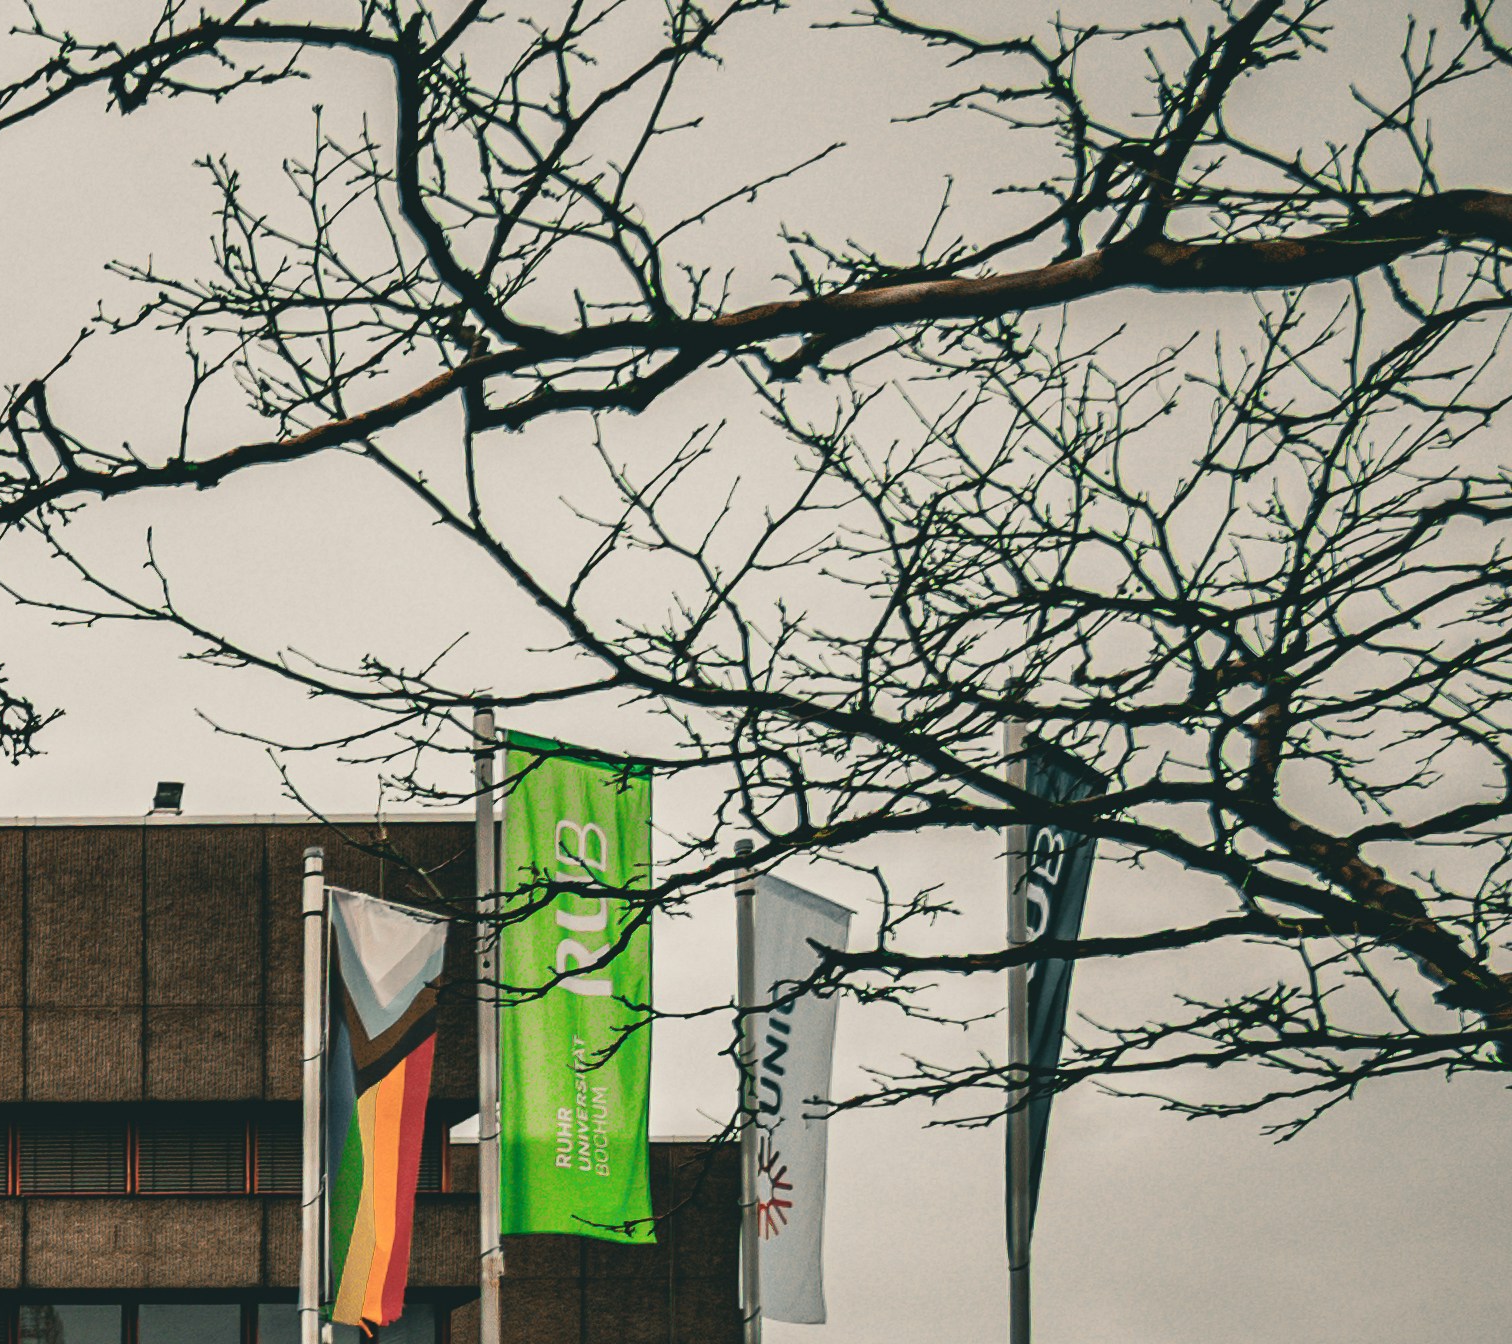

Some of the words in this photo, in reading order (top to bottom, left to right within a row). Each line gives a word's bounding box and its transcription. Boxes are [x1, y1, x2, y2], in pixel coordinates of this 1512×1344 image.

[555, 819, 613, 998] RUB
[555, 1106, 574, 1170] RUHR
[591, 1086, 611, 1177] BOCHUM
